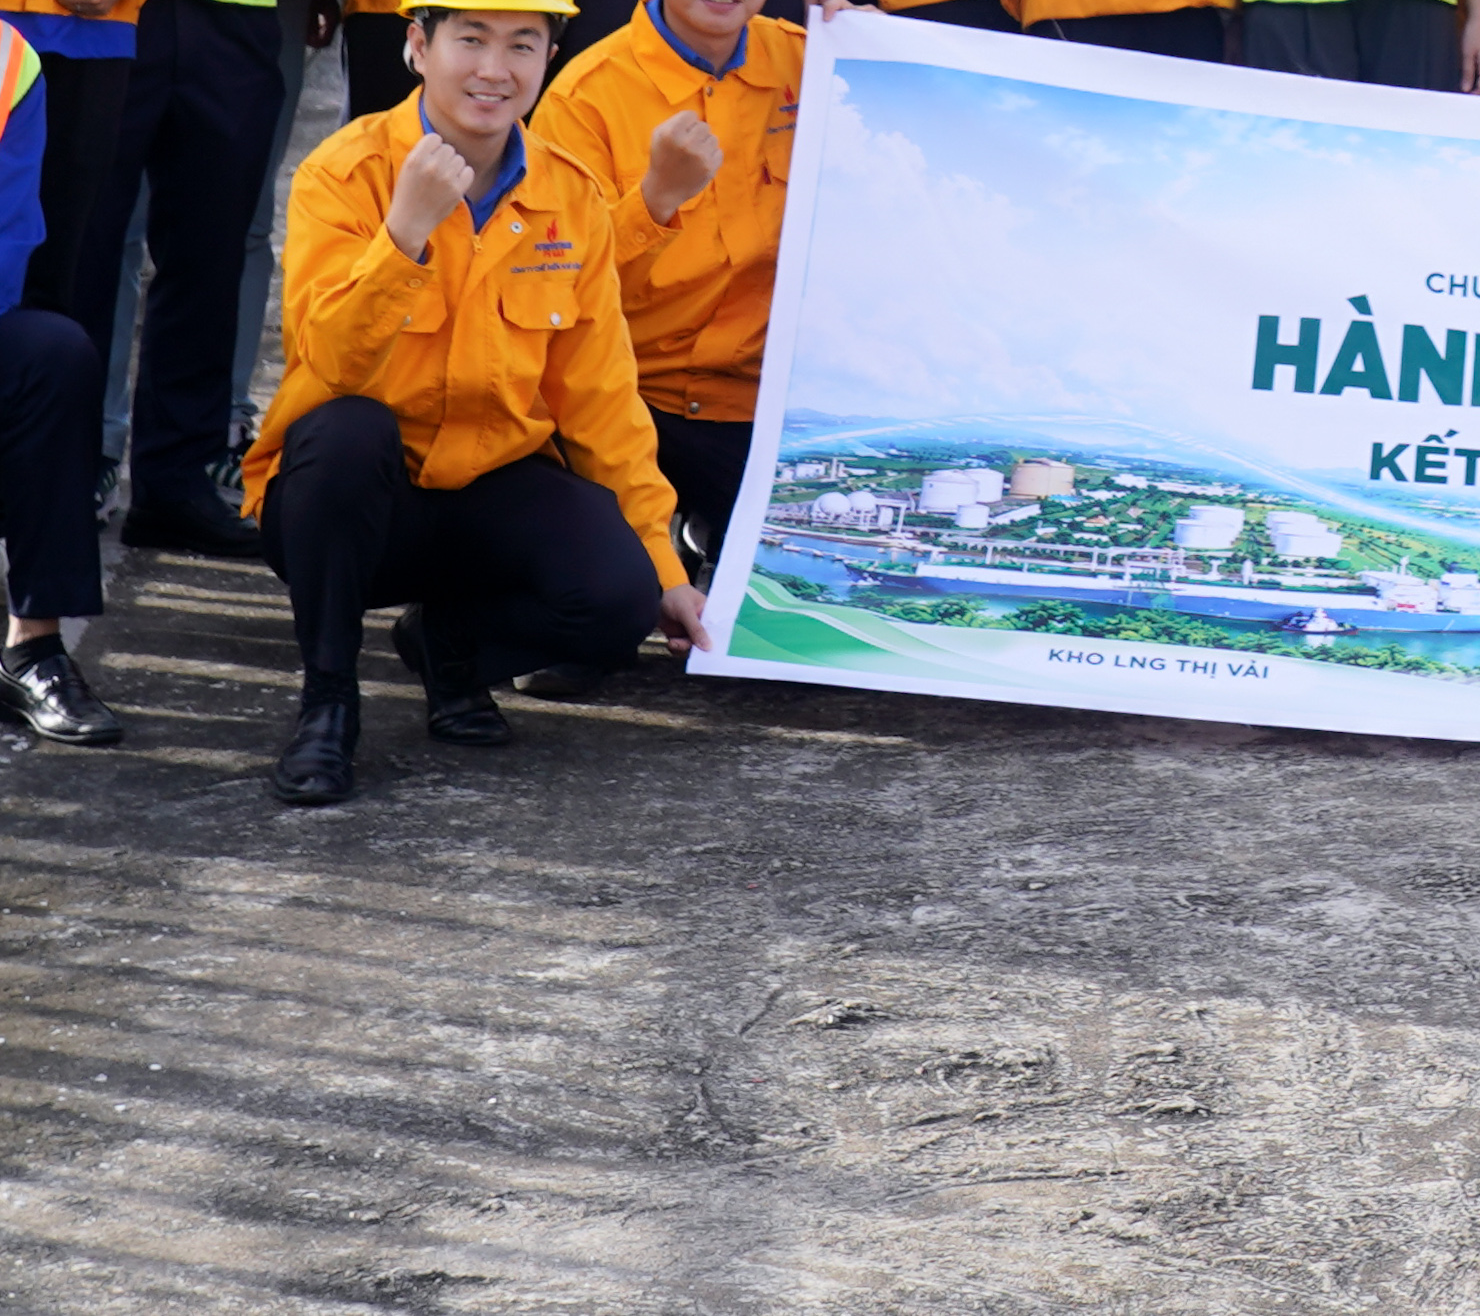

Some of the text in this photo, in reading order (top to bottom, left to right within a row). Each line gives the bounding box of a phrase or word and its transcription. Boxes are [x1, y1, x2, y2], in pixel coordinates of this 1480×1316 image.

[1049, 649, 1268, 678] KHO LNG THỊ VẢI
